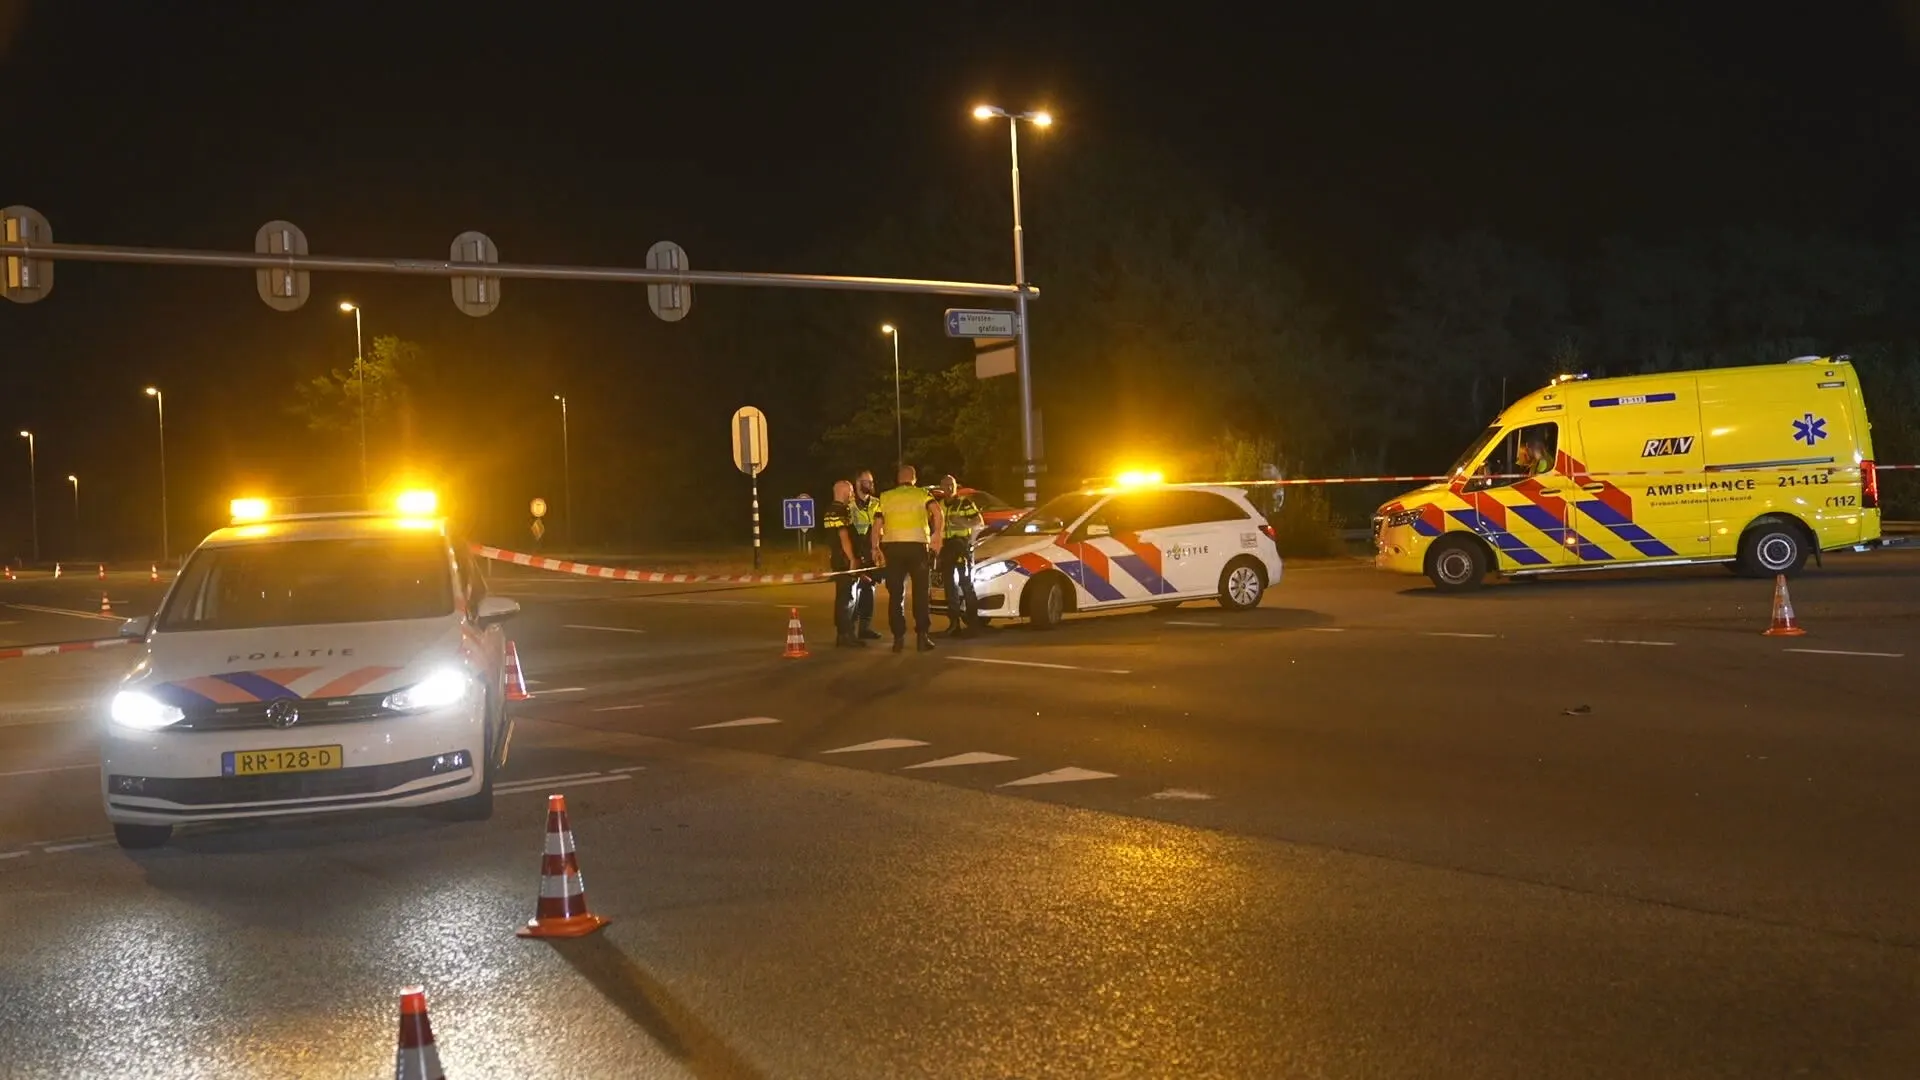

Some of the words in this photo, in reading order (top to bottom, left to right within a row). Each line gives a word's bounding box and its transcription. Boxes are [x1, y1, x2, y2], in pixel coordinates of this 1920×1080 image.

[1643, 437, 1693, 456] RAV
[1646, 479, 1755, 496] AMBULANCE
[1778, 474, 1829, 488] 21-113
[226, 648, 355, 664] POLITIE
[242, 750, 331, 771] RR-128-D
